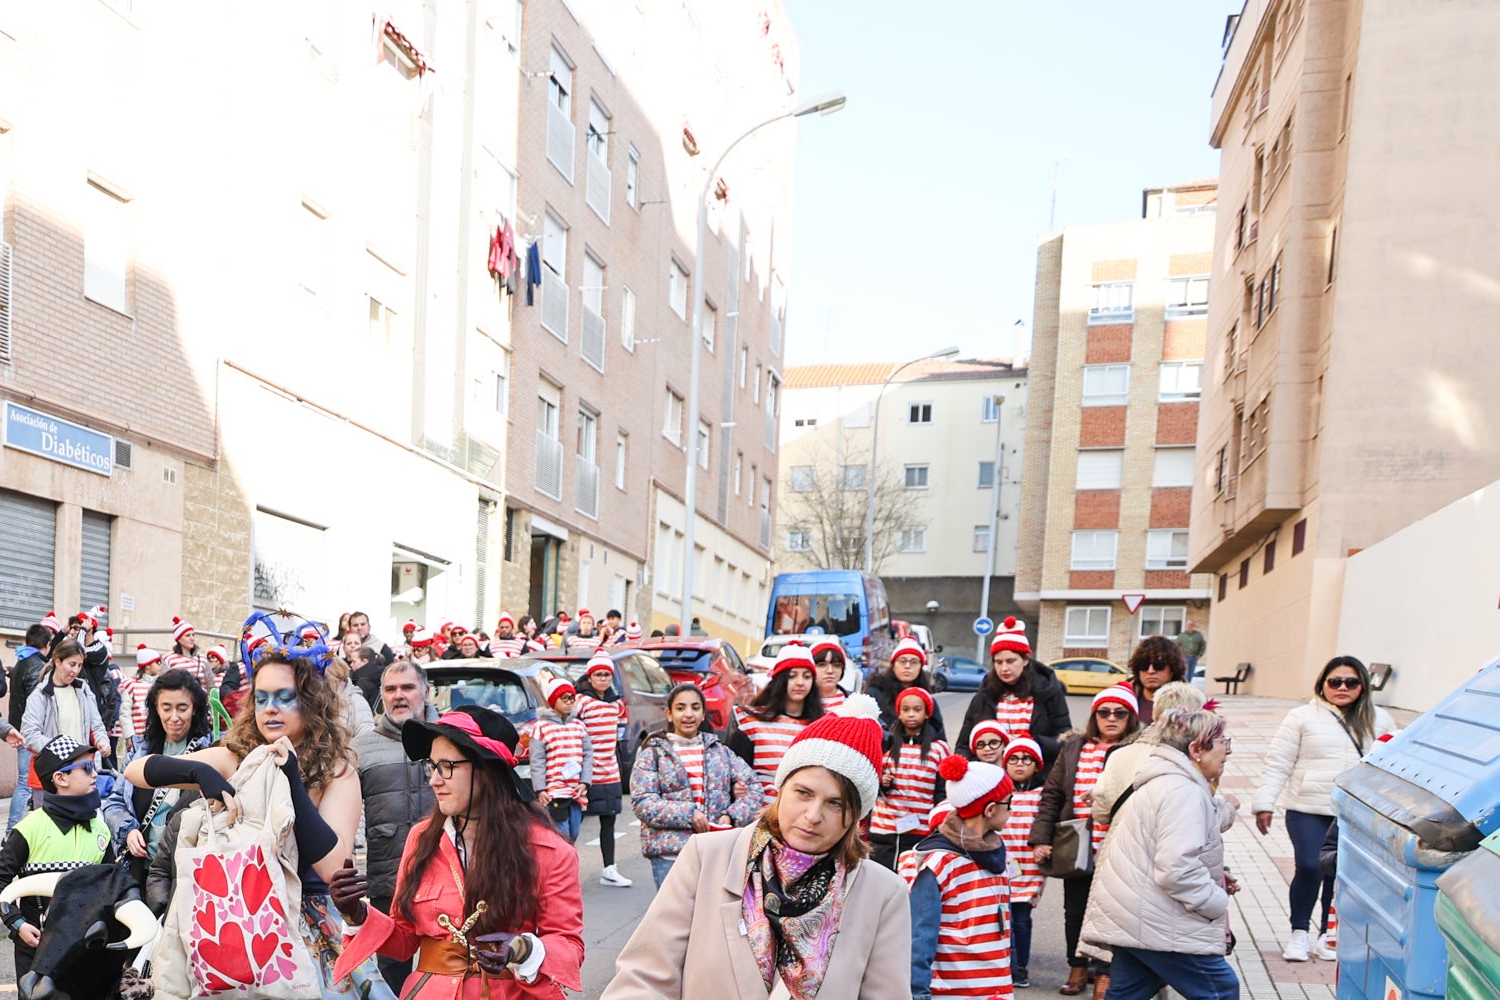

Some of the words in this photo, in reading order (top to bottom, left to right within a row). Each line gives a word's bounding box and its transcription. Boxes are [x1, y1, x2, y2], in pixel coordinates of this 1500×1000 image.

[10, 408, 48, 431] Asociación
[48, 422, 58, 434] de
[41, 431, 111, 470] Diabéticos
